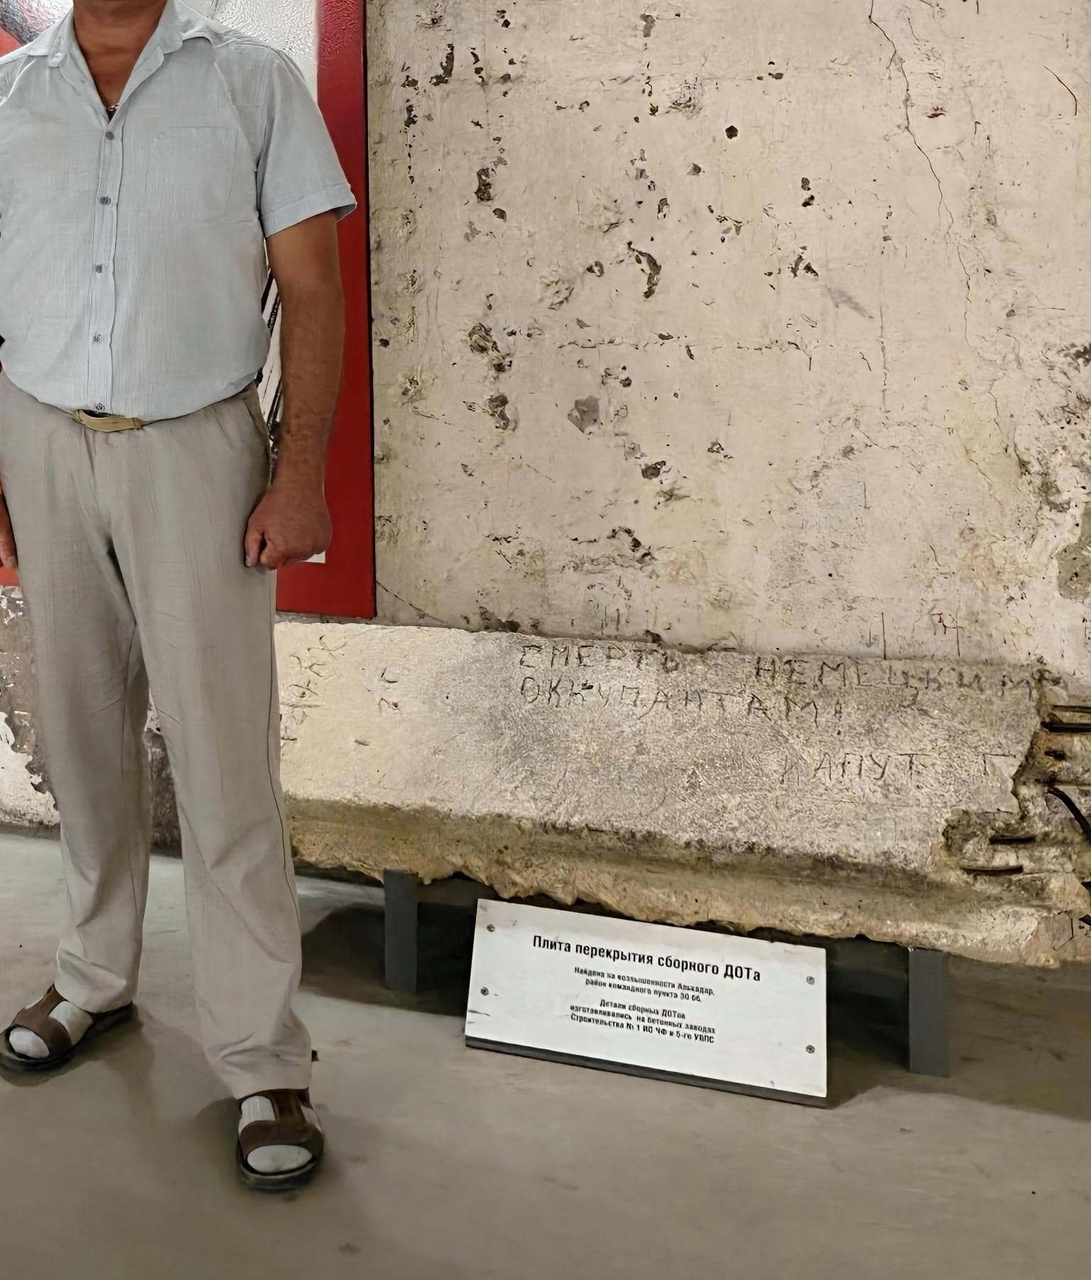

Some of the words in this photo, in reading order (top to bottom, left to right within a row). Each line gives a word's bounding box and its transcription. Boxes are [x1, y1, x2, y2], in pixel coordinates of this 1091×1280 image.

[533, 935, 571, 953] Плита
[575, 944, 654, 965] перекрытия
[658, 956, 719, 975] сборного
[723, 964, 761, 982] ДОТа
[599, 999, 626, 1010] Детали
